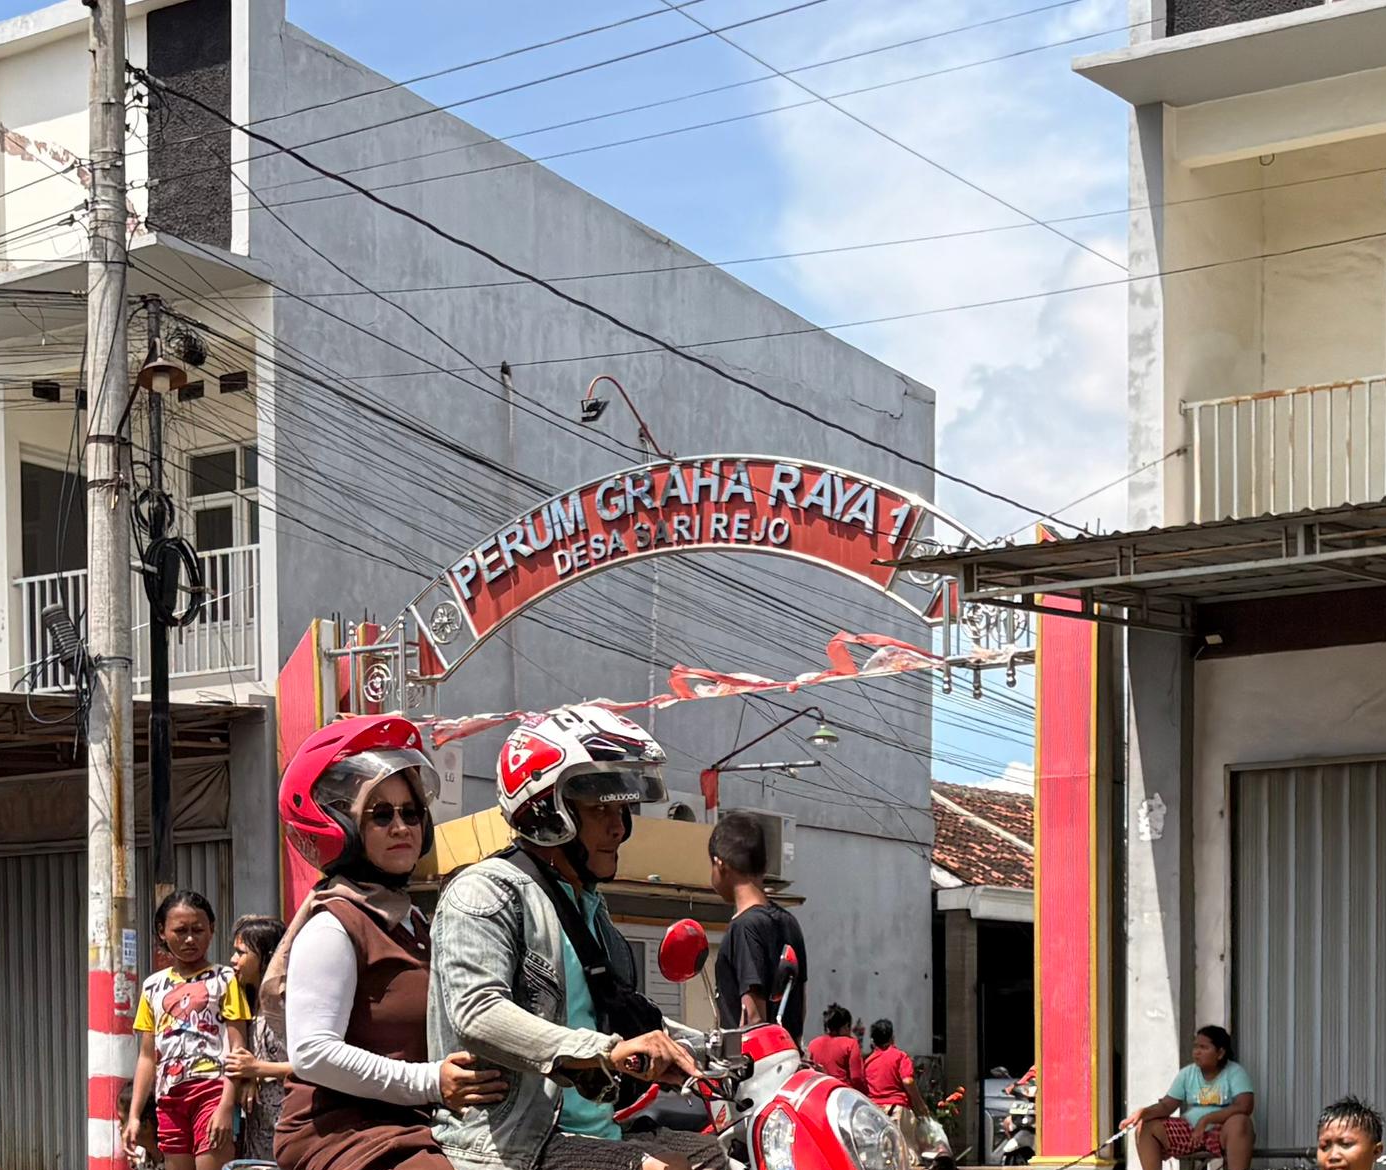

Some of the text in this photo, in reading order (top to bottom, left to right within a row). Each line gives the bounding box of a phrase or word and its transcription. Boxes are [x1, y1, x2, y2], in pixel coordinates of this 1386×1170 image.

[451, 459, 912, 601] PERUM GRAHA RAYA 1
[552, 512, 791, 577] DESA SARI REJO
